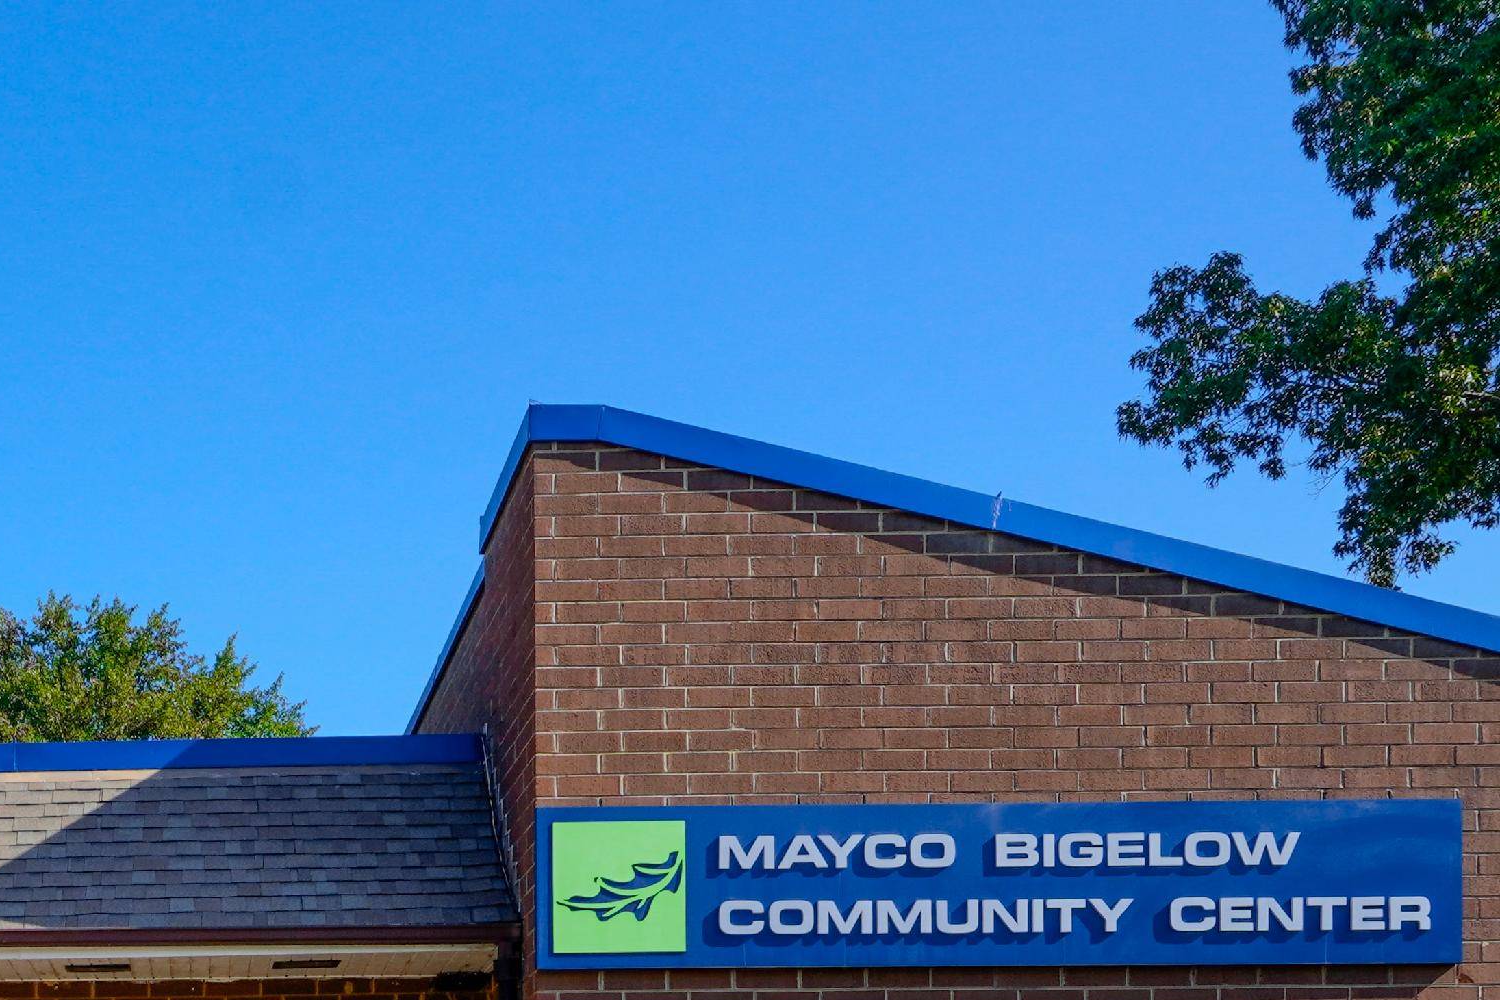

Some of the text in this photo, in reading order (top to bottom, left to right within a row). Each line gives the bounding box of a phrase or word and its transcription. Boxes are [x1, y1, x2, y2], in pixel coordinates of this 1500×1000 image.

[718, 831, 1300, 870] MAYCO BIGELOW
[718, 895, 1432, 936] COMMUNITY CENTER
